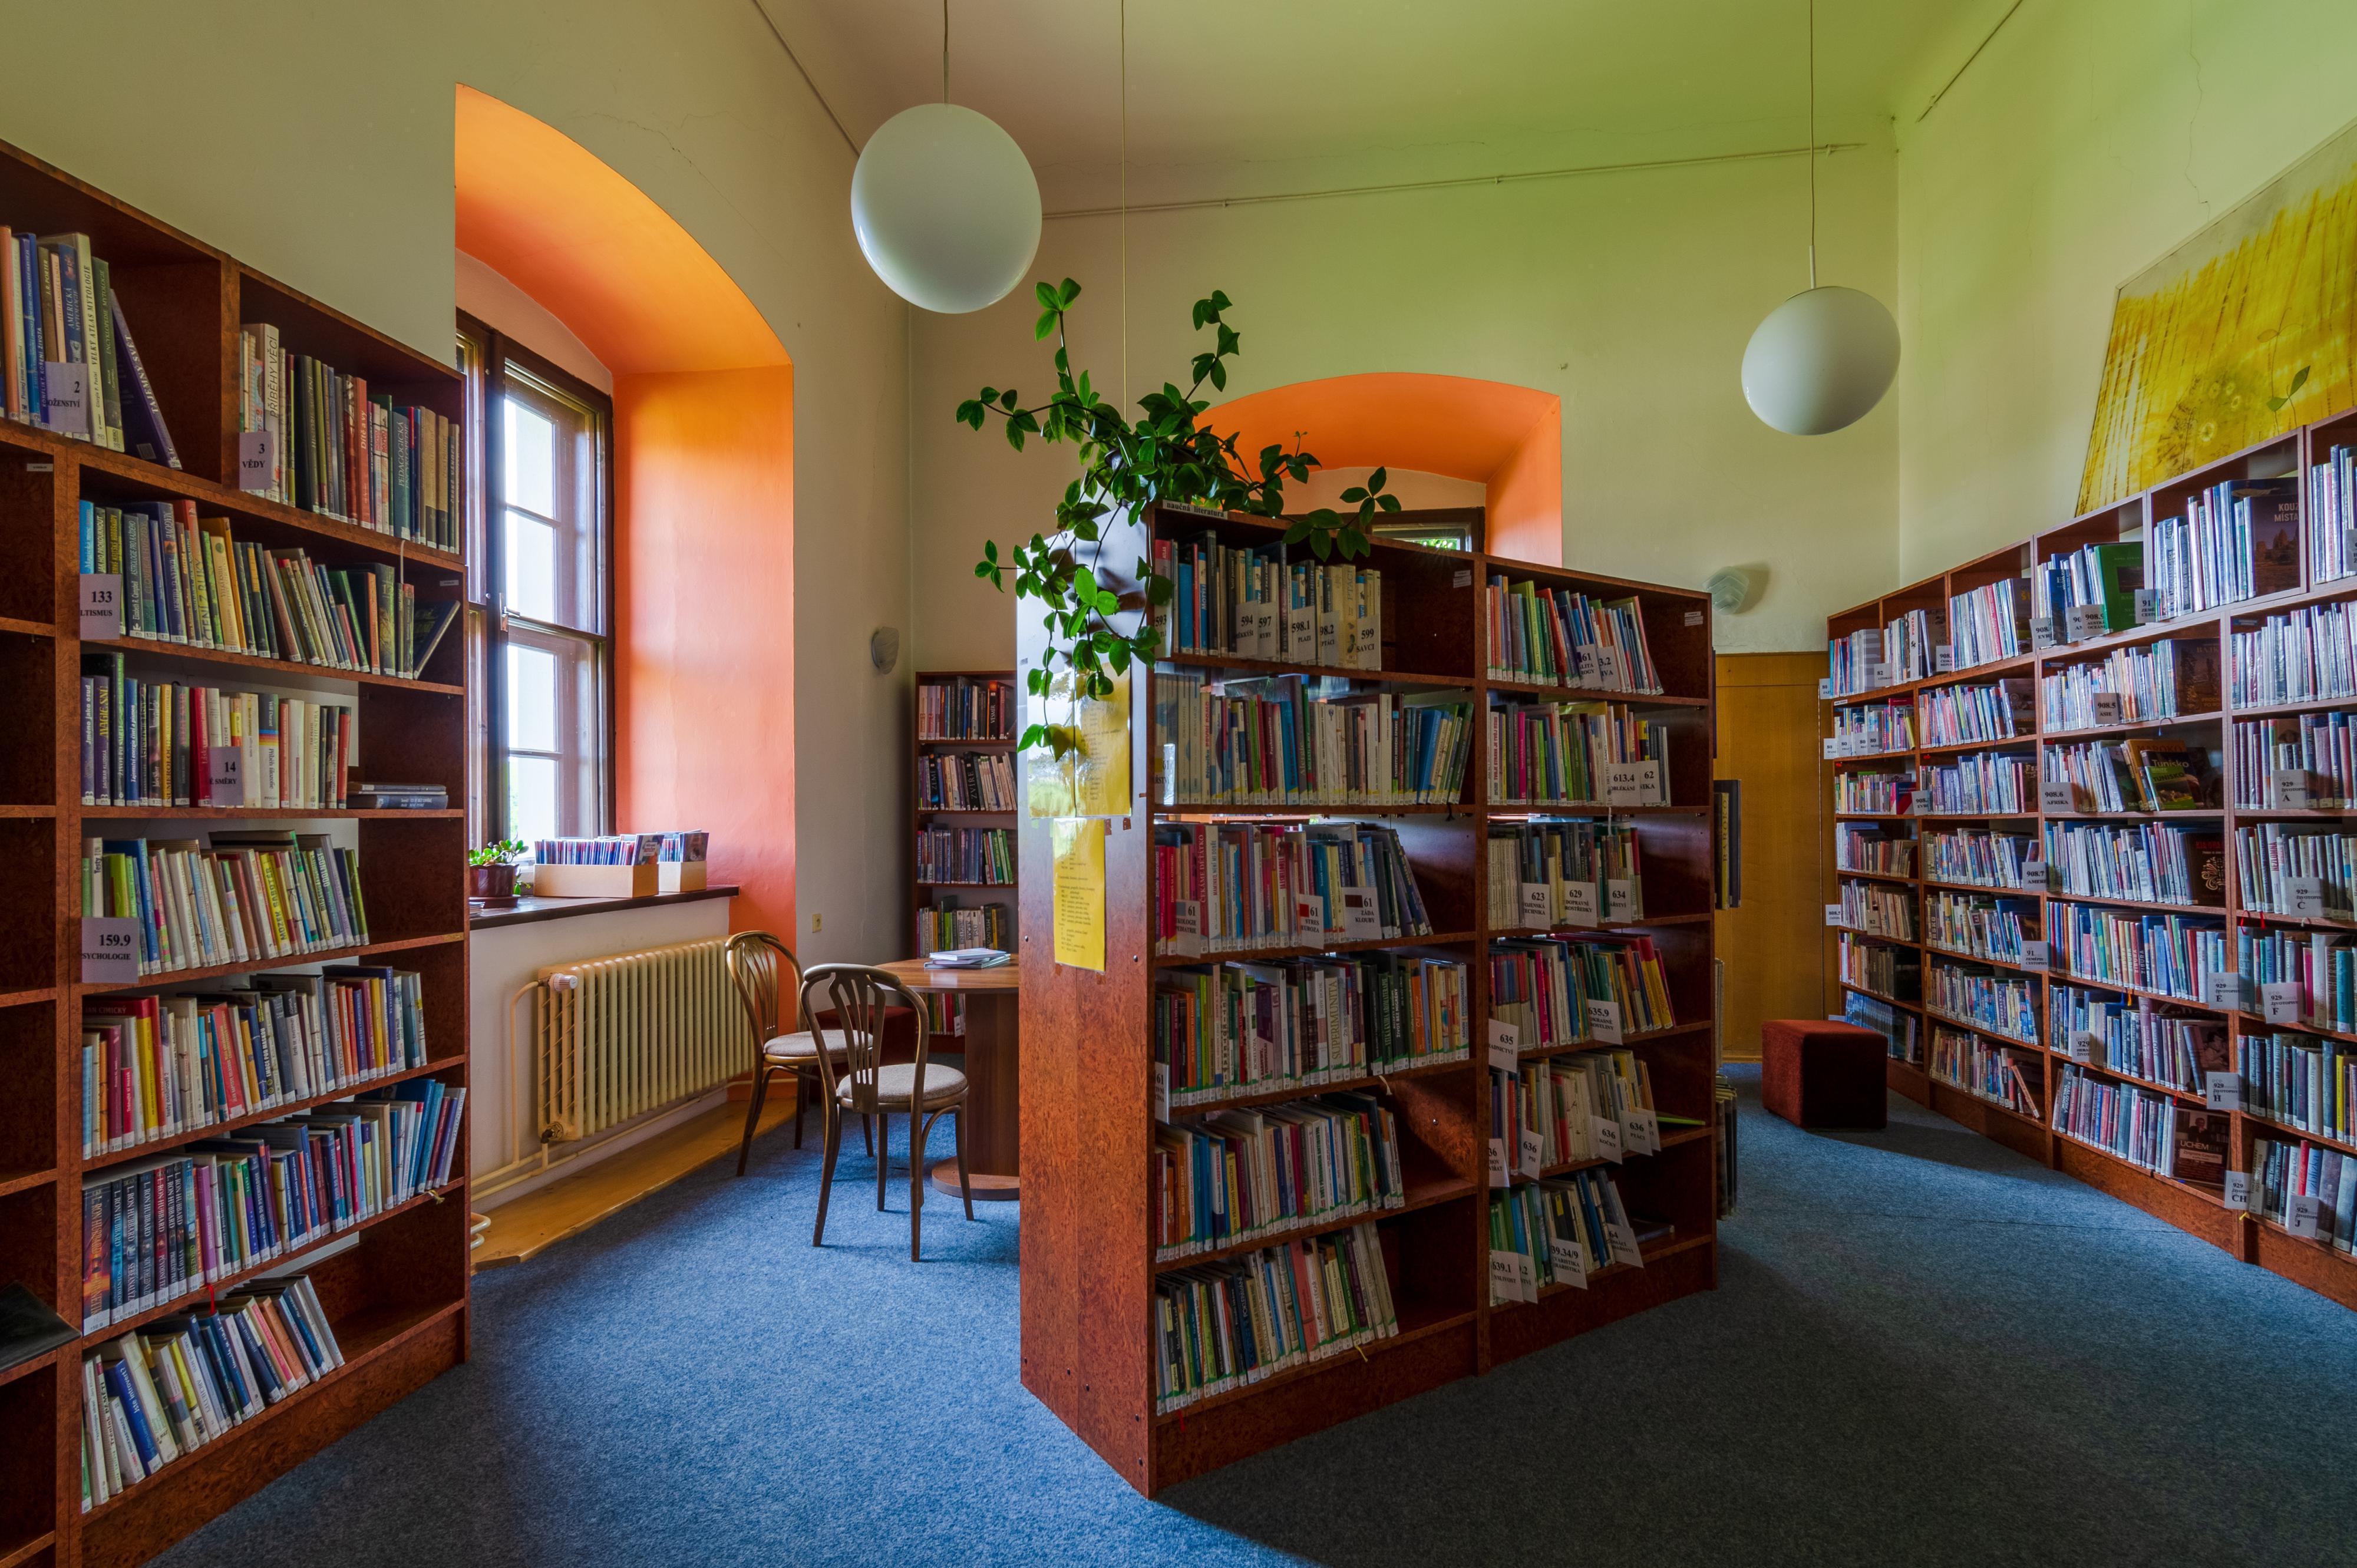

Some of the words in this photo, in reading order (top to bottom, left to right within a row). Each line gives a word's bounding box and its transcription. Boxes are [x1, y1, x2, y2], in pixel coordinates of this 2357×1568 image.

[83, 265, 92, 311] MYTOLOGIE
[65, 288, 75, 328] AMERICKÁ
[87, 313, 95, 337] ATLAS
[90, 341, 98, 365] VELKÝ
[267, 335, 278, 364] VĚCÍ
[74, 381, 80, 393] 2
[268, 367, 279, 418] PŘÍBĚHY
[259, 443, 265, 454] 3
[242, 459, 265, 468] VĚDY
[1167, 502, 1190, 512] naučná
[1194, 505, 1224, 518] literatura
[2279, 503, 2299, 511] KOUZ
[2274, 513, 2299, 523] MÍSTA
[91, 591, 113, 603] 133
[1155, 614, 1167, 627] 593
[1241, 615, 1253, 628] 594
[1259, 616, 1272, 628] 597
[1291, 620, 1310, 633] 598.1
[1320, 625, 1334, 636] 98.2
[1361, 628, 1375, 640] 599
[1356, 643, 1375, 653] SAVCI
[99, 706, 109, 737] MAGIE
[225, 761, 236, 772] 14
[2151, 759, 2190, 768] Tunisko
[1613, 774, 1635, 783] 613.4
[1644, 771, 1654, 779] 62
[2153, 772, 2184, 782] TUNISKO
[316, 852, 331, 887] ODOLNOST
[265, 867, 279, 907] SABOTÉR
[1531, 892, 1545, 901] 623
[1569, 889, 1582, 898] 629
[1612, 890, 1626, 899] 634
[1364, 897, 1372, 907] 61
[2297, 902, 2306, 910] C
[1188, 906, 1196, 916] 61
[1310, 907, 1318, 917] 61
[275, 910, 288, 940] MOZEK
[100, 934, 131, 946] 159.9
[1588, 1007, 1609, 1017] 635.9
[1328, 980, 1341, 1060] SUPERIMUNITA
[260, 1027, 268, 1049] MASKOU
[1500, 1034, 1514, 1045] 635
[1157, 1074, 1164, 1085] 61
[1630, 1122, 1644, 1132] 636
[1602, 1128, 1616, 1139] 636
[1630, 1133, 1646, 1141] PTÁCI
[1523, 1141, 1537, 1153] 636
[1599, 1138, 1616, 1148] KOČKY
[2180, 1140, 2209, 1150] UCHEM
[1488, 1148, 1497, 1156] 36
[91, 1203, 102, 1216] RON
[175, 1193, 183, 1225] HUBBARD
[126, 1209, 134, 1242] HUBBARD
[143, 1203, 151, 1237] HUBBARD
[91, 1217, 103, 1255] HUBBARD
[1551, 1245, 1579, 1259] 39.34/9
[120, 1366, 136, 1398] introvert?
[100, 1381, 111, 1414] PAMĚTI
[130, 1399, 141, 1414] Jste
[106, 1416, 115, 1446] Trénink
